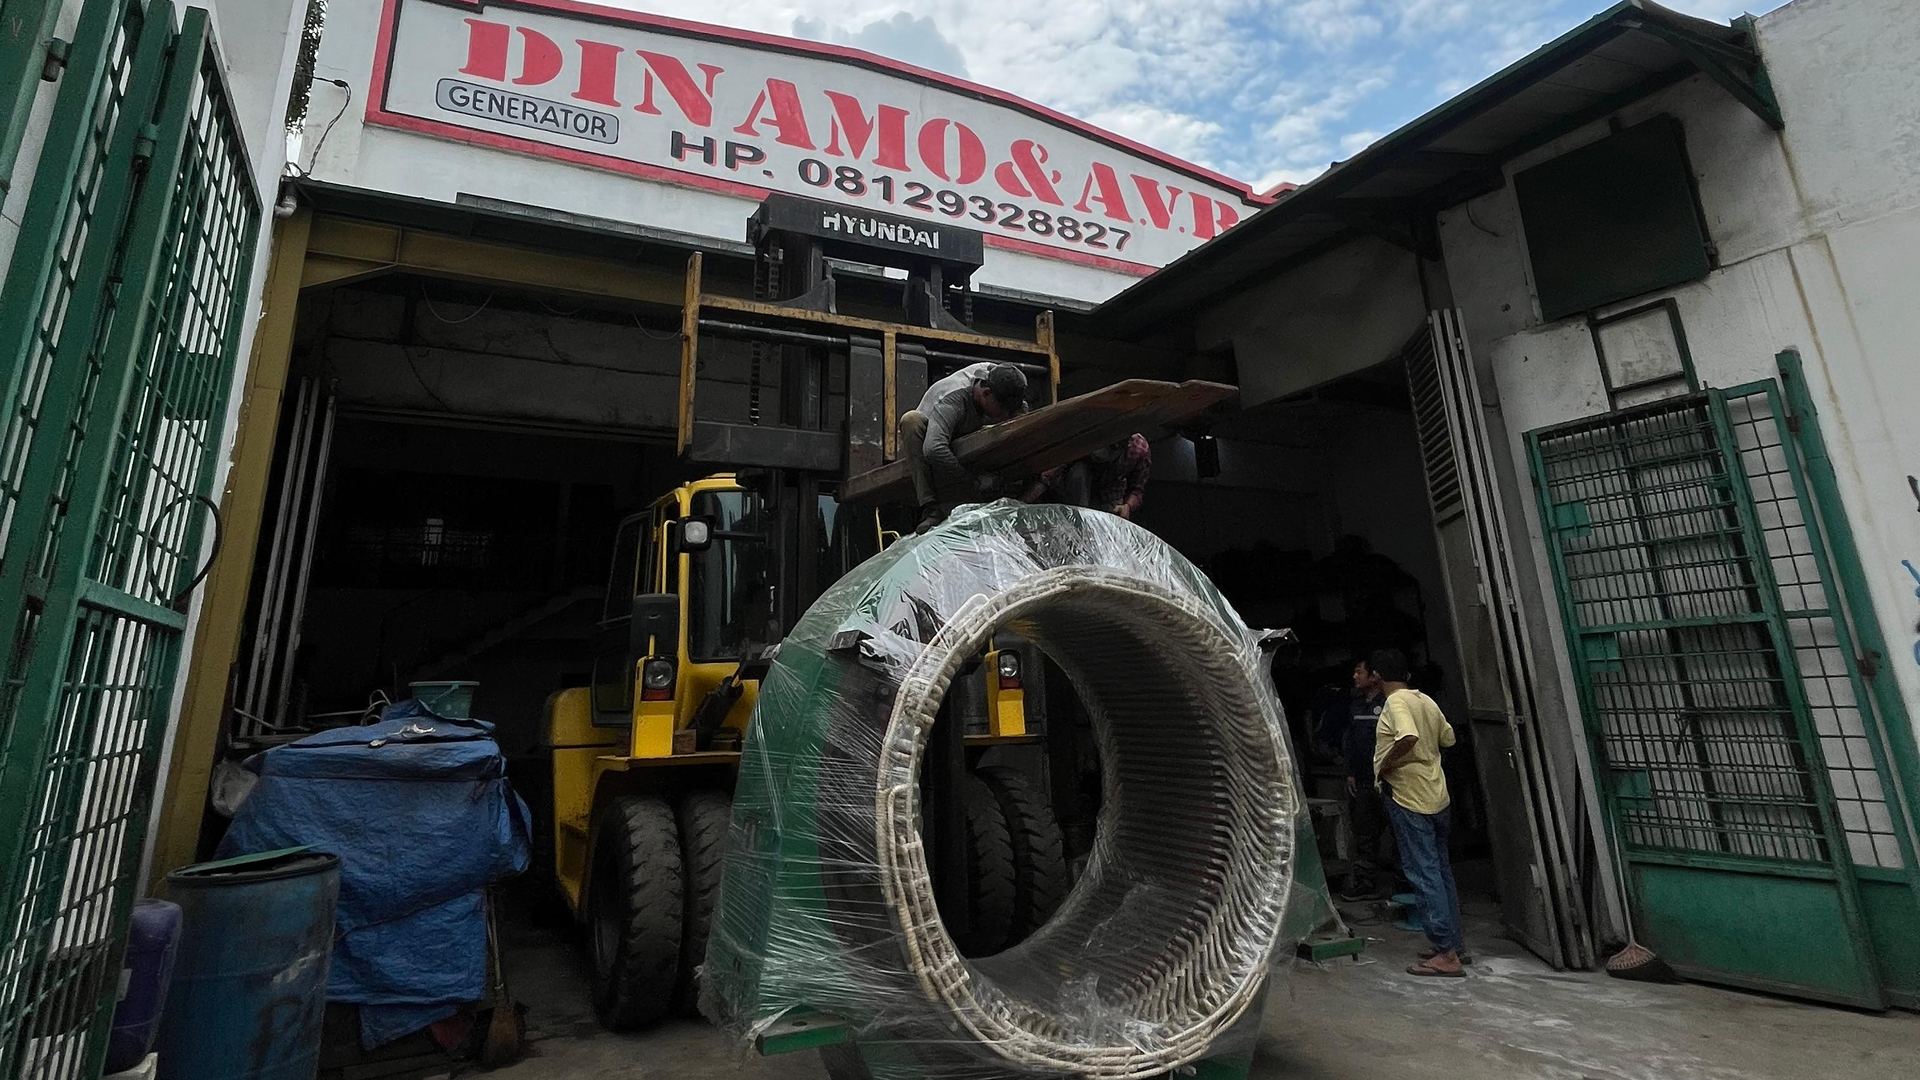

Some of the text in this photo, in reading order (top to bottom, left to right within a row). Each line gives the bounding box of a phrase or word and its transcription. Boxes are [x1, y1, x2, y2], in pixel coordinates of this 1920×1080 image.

[449, 85, 608, 139] GENERATOR
[671, 130, 1132, 252] HP. 08129328827
[822, 210, 940, 249] HYUNDAI
